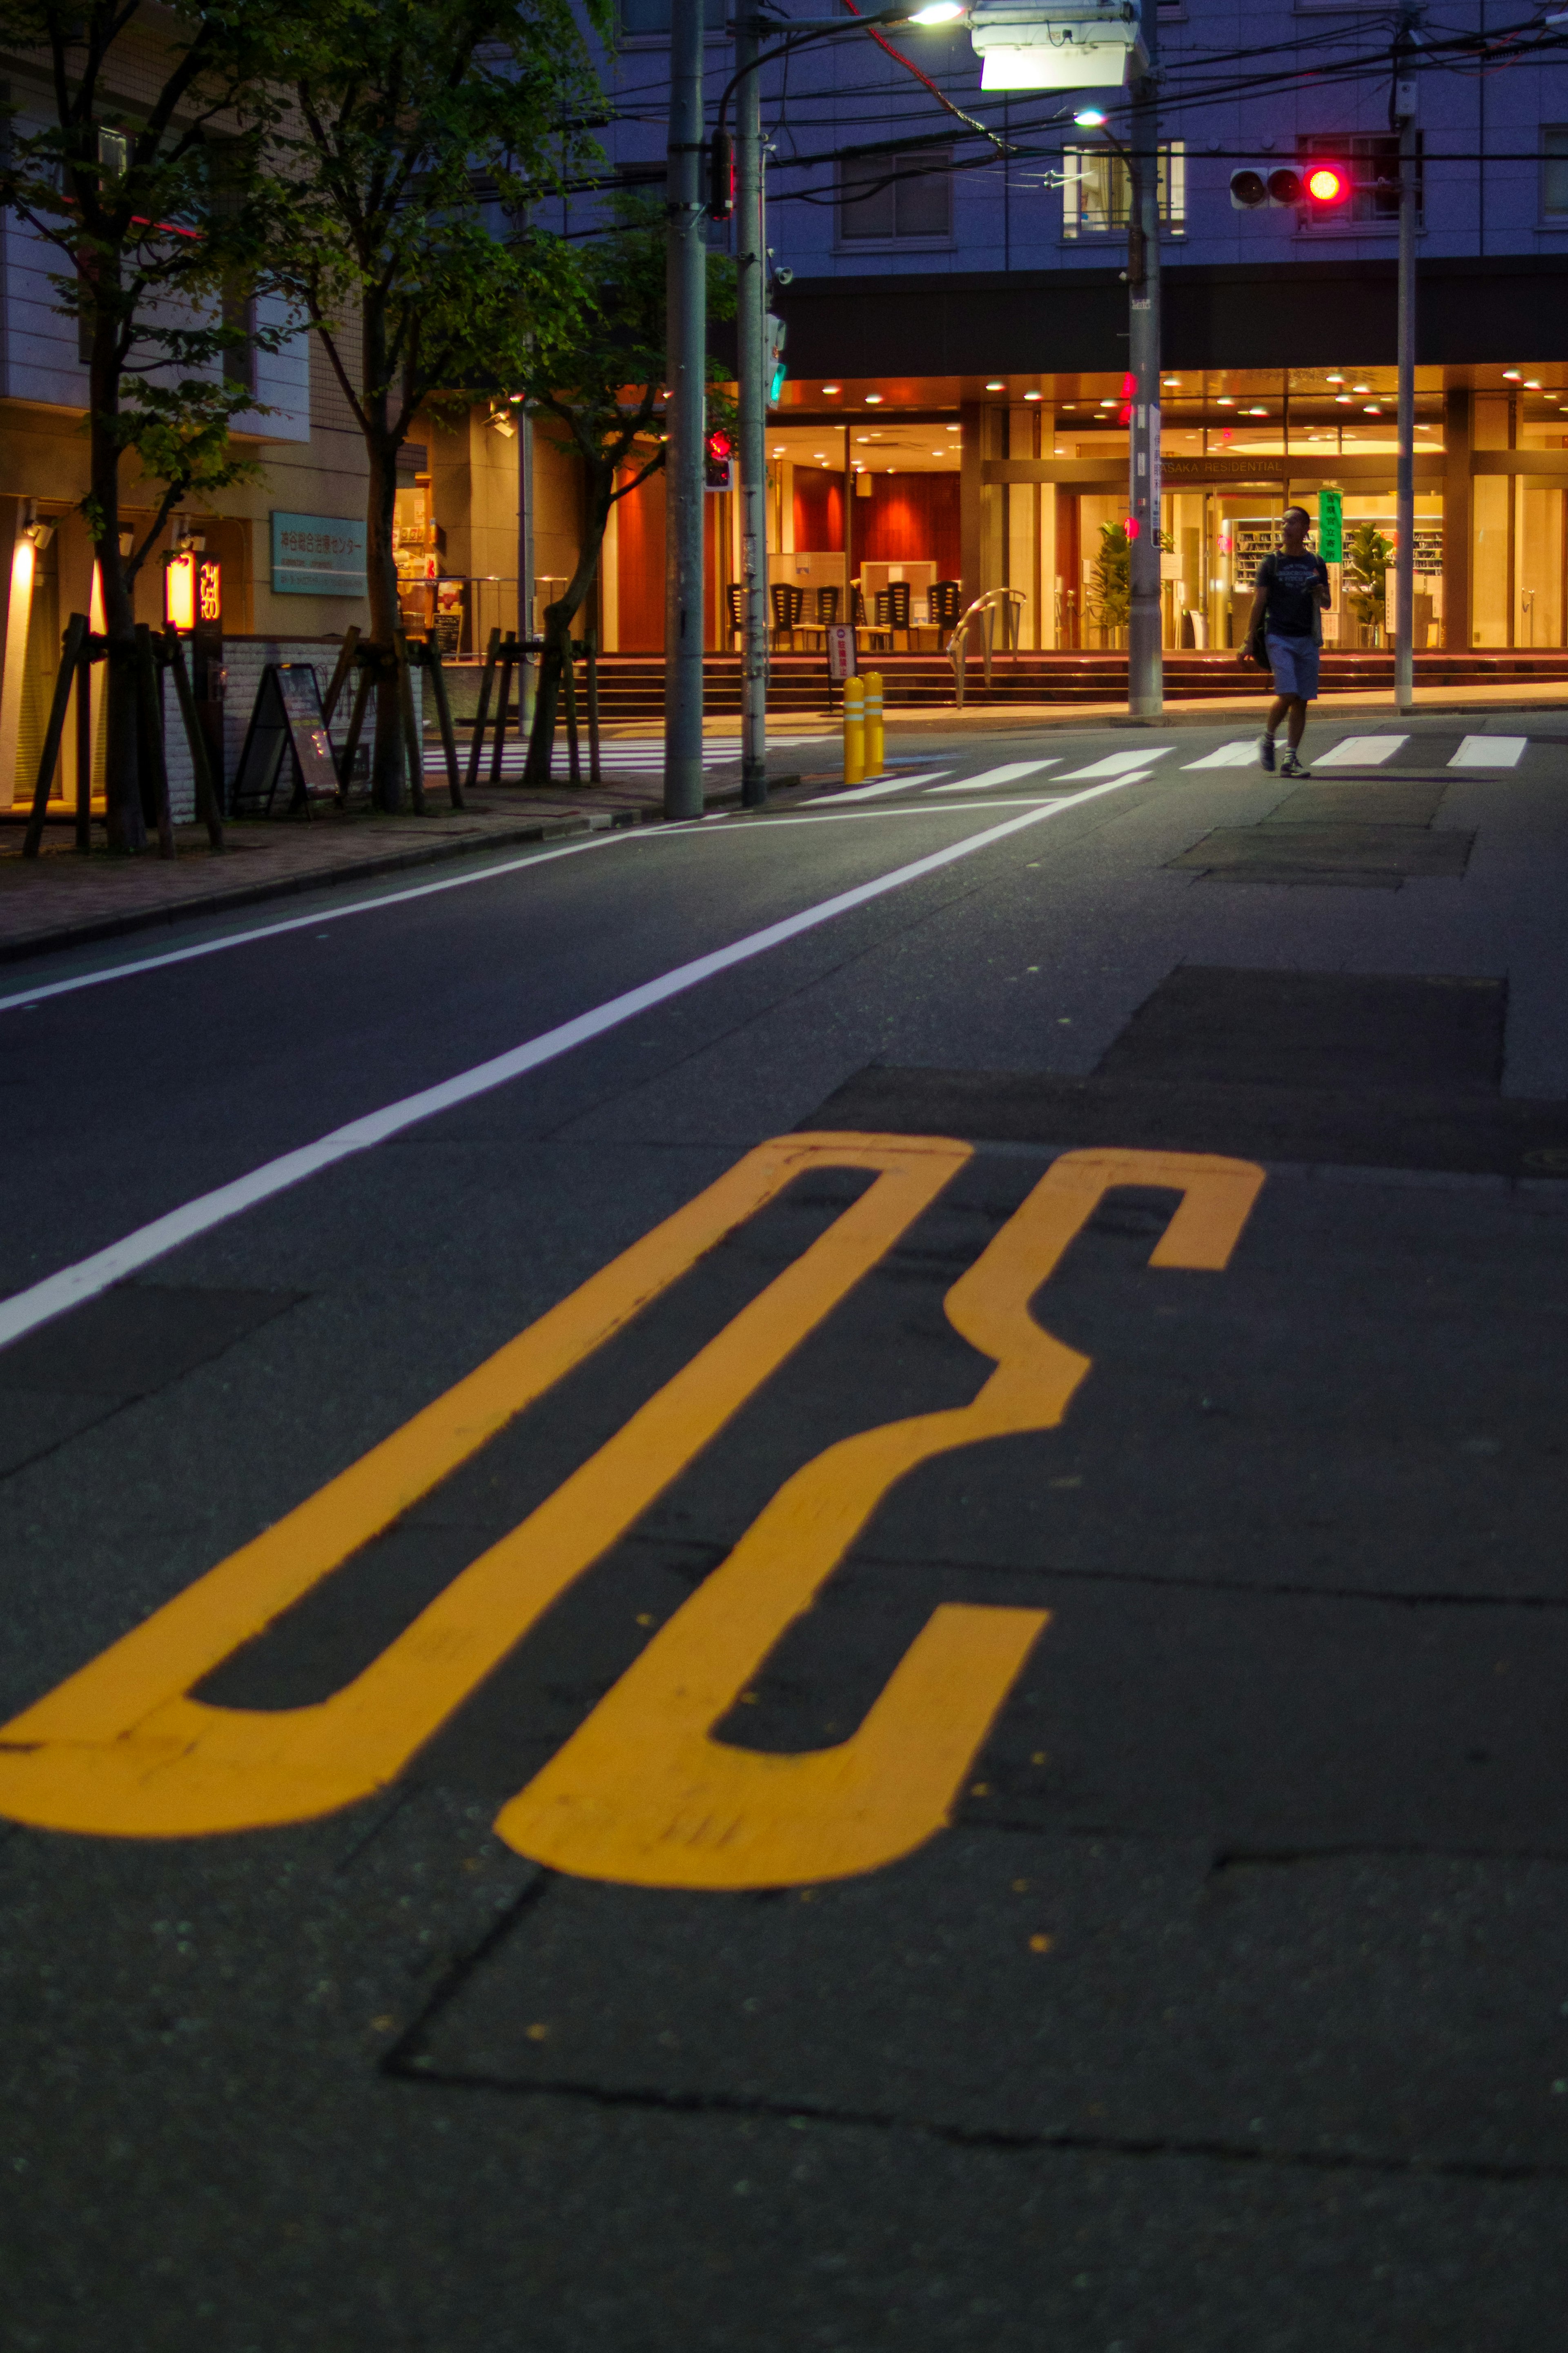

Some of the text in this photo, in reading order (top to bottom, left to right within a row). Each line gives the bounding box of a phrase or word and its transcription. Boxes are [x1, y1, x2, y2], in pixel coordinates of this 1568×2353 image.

[1204, 462, 1282, 472] RESIDENTIAL
[1325, 494, 1336, 559] 警察官立寄所
[281, 530, 362, 554] 神谷総合治療センター
